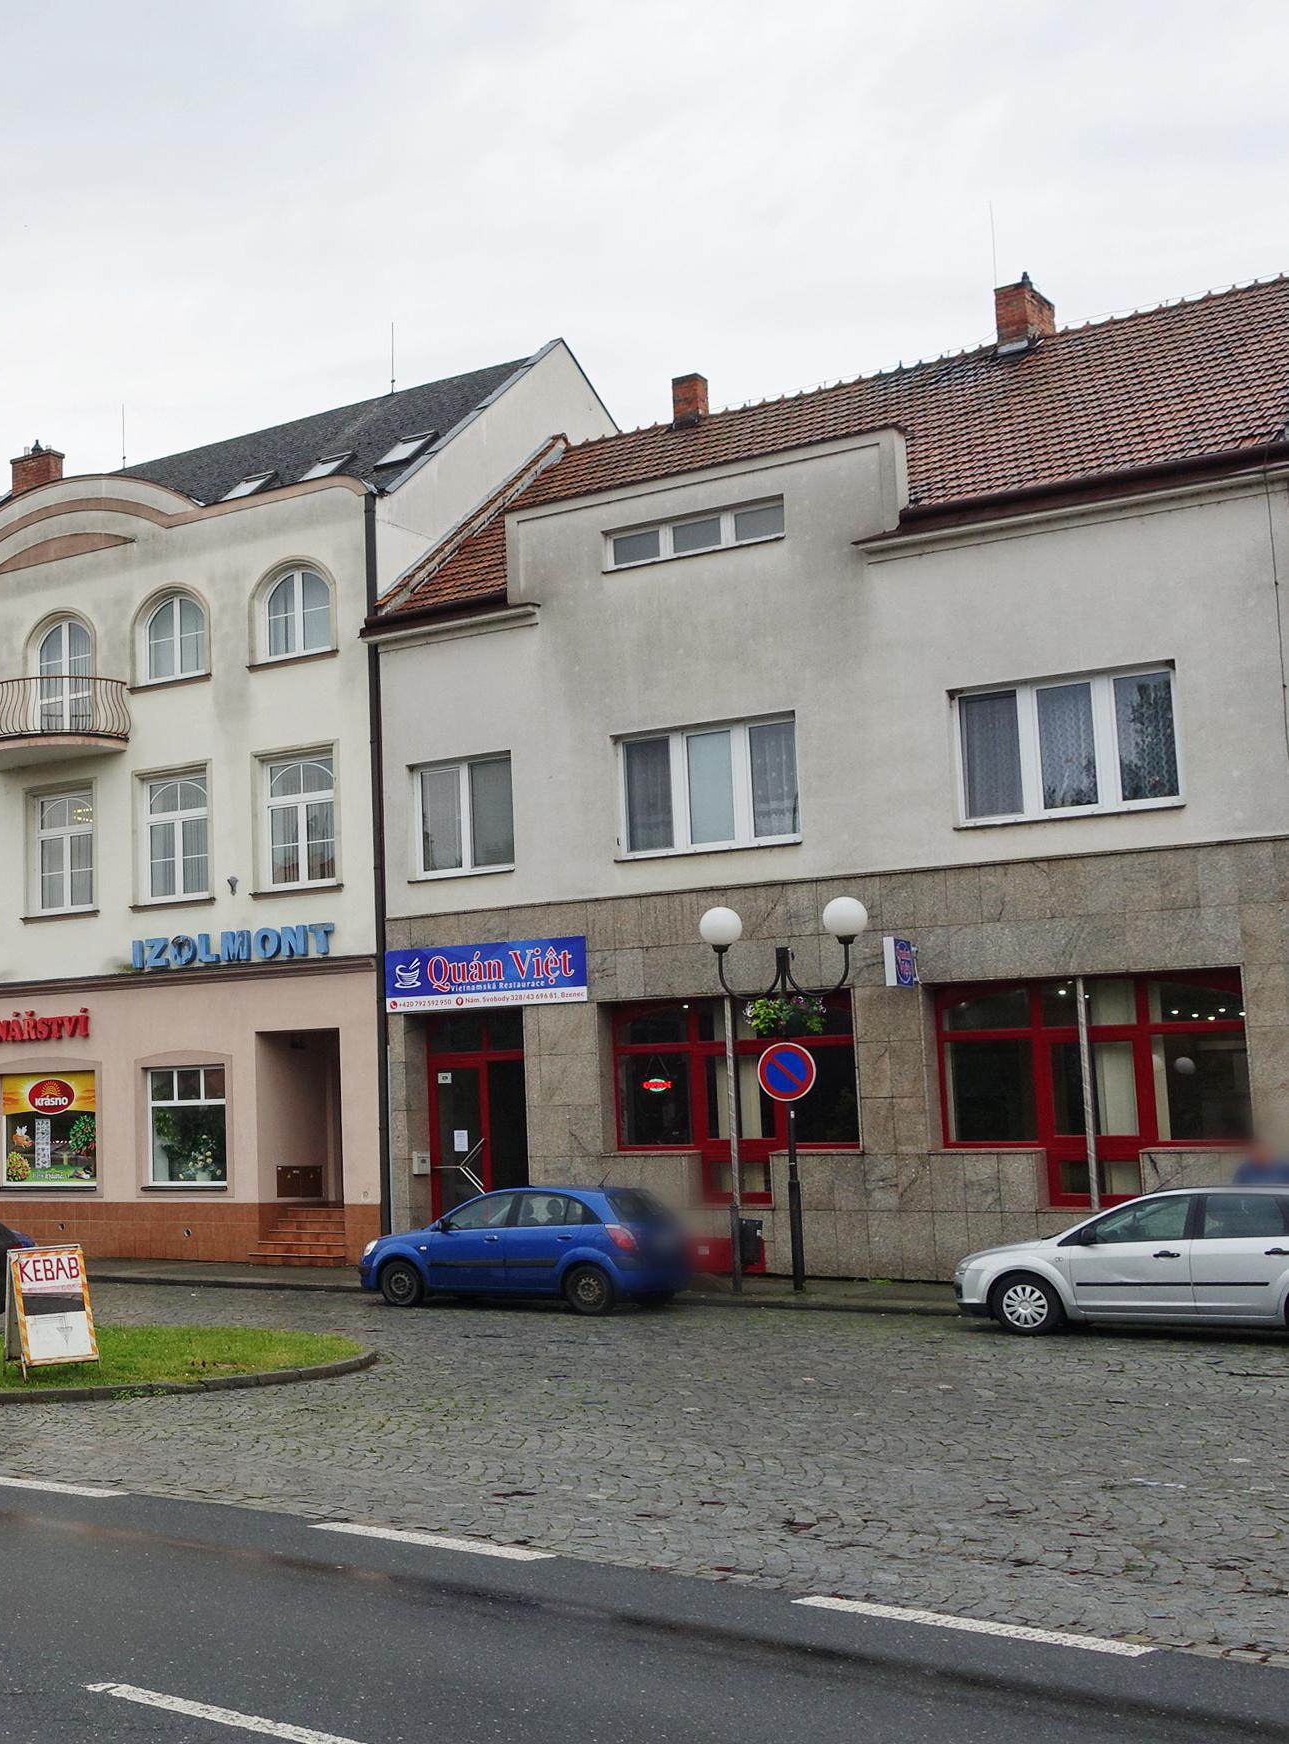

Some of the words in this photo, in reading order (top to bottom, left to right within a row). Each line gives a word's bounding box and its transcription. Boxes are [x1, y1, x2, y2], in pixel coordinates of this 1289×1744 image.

[131, 922, 335, 970] IZOLMONT
[427, 951, 504, 992] Quán
[508, 946, 575, 985] Việt
[482, 994, 510, 1003] Svobody
[499, 980, 545, 990] Restaurace
[18, 1256, 80, 1283] KEBAB
